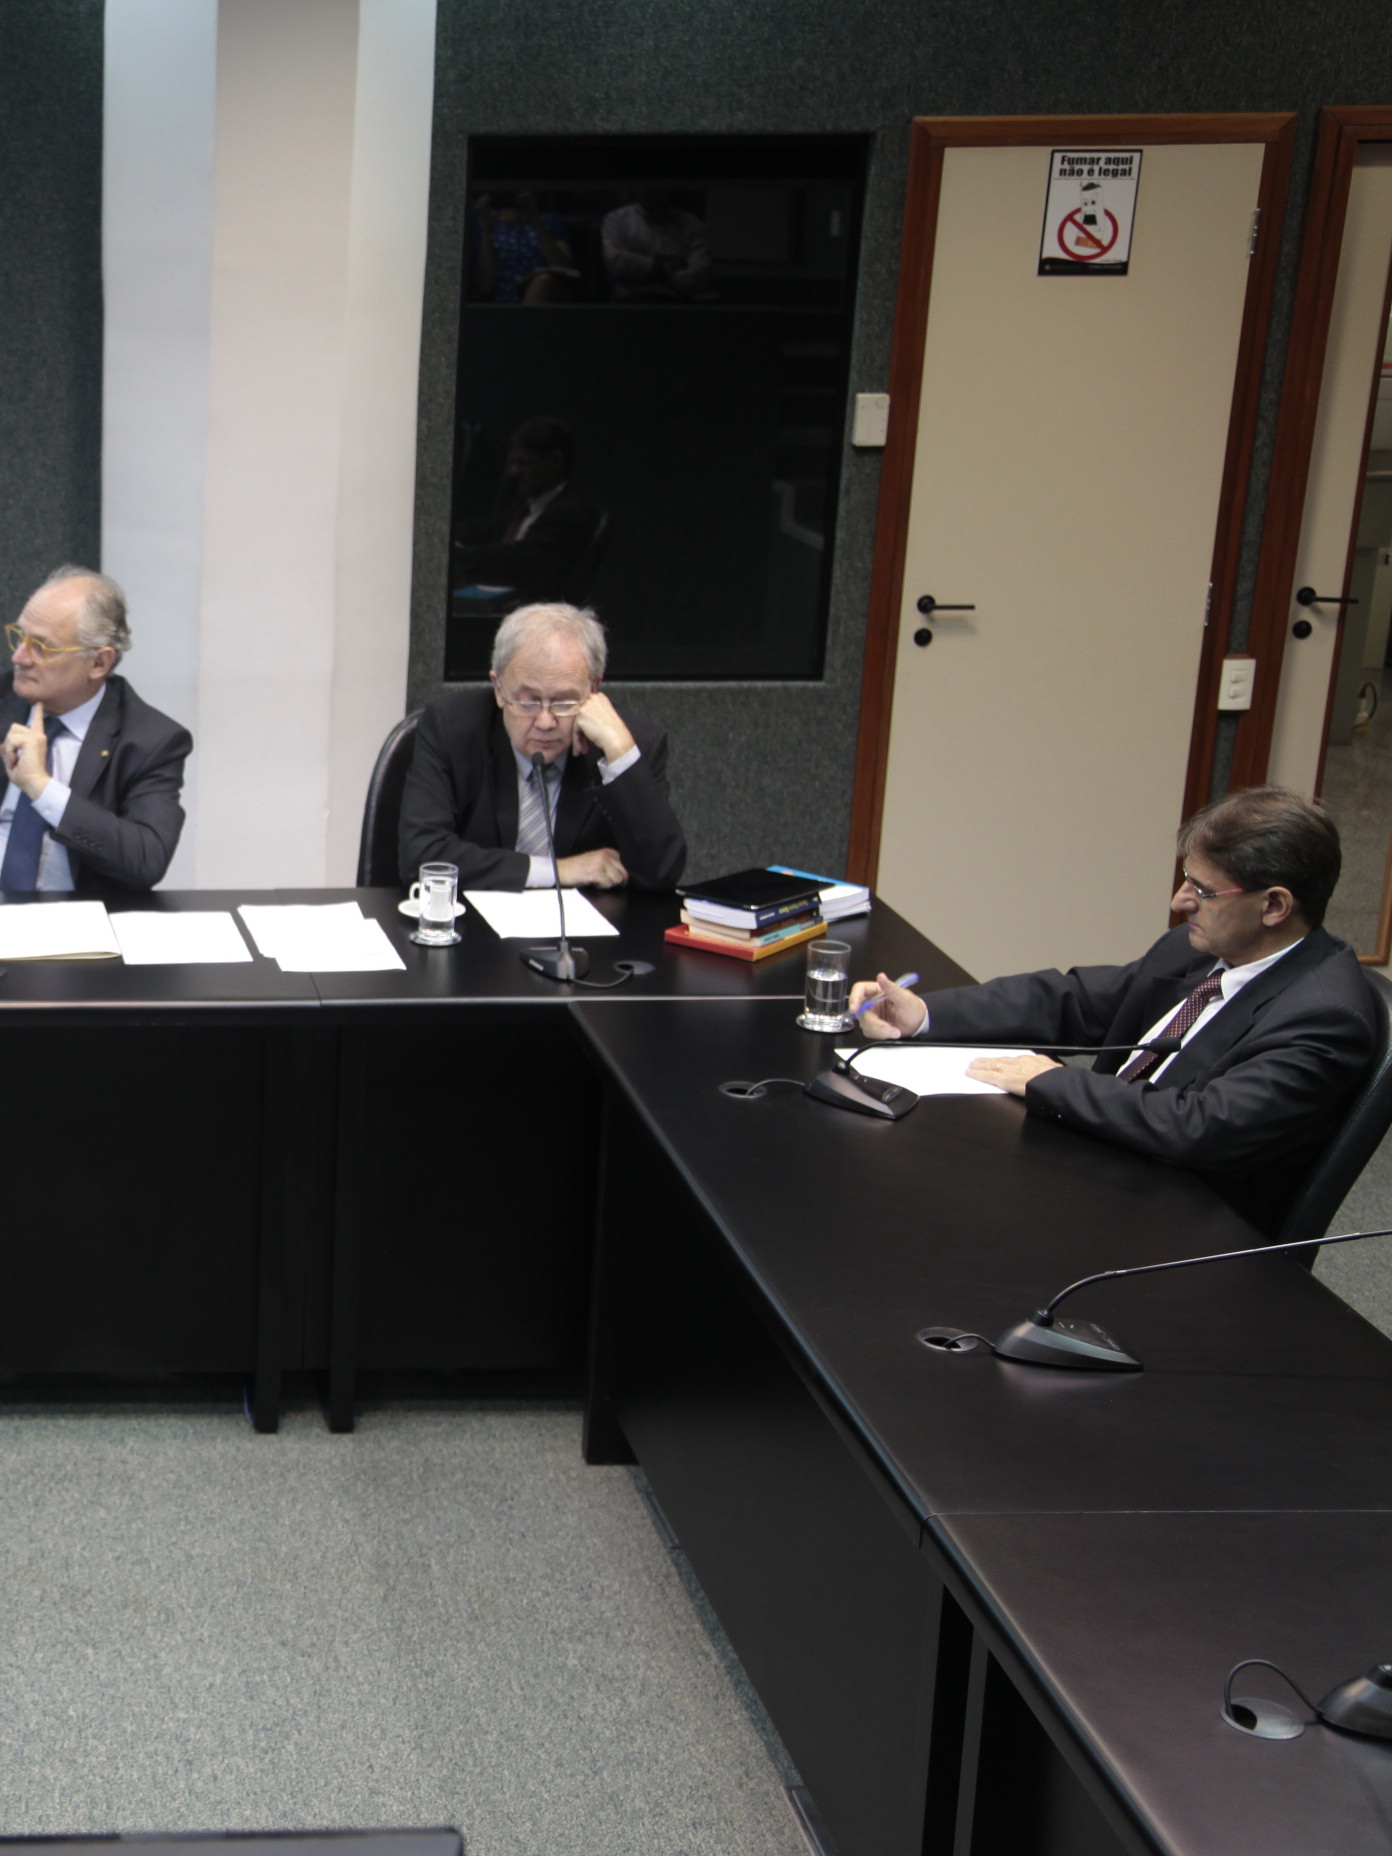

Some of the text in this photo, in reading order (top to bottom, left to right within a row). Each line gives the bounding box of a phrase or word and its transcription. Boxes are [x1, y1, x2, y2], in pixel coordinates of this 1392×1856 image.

[1061, 155, 1133, 167] Fumar aqui
[1059, 166, 1133, 178] não é legal
